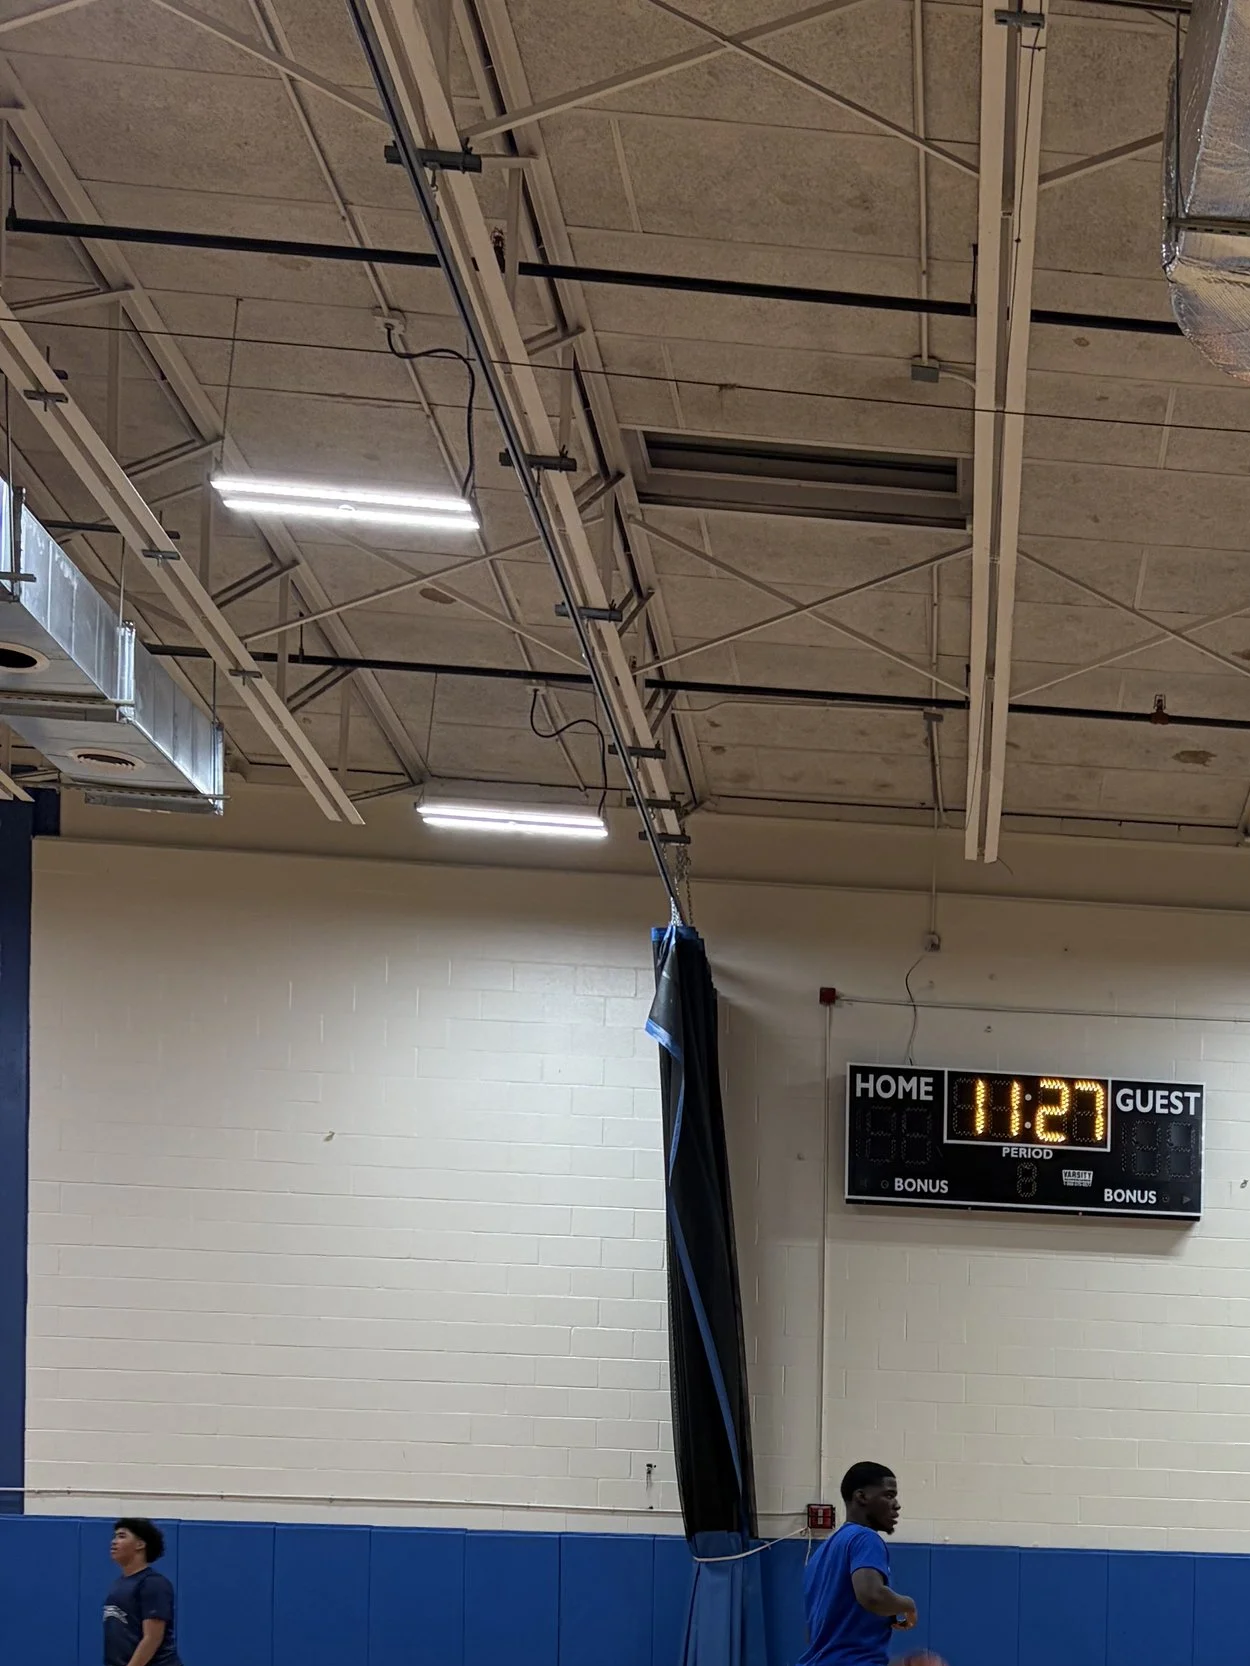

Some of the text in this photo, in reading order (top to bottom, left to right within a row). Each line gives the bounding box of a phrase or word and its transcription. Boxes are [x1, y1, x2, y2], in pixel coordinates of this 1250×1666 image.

[855, 1073, 934, 1101] HOME
[1115, 1087, 1201, 1115] GUEST
[975, 1078, 1105, 1143] 11:27
[1002, 1146, 1053, 1160] PERIOD
[1063, 1170, 1092, 1179] VARSITY
[894, 1177, 949, 1194] BONUS
[1104, 1188, 1157, 1204] BONUS
